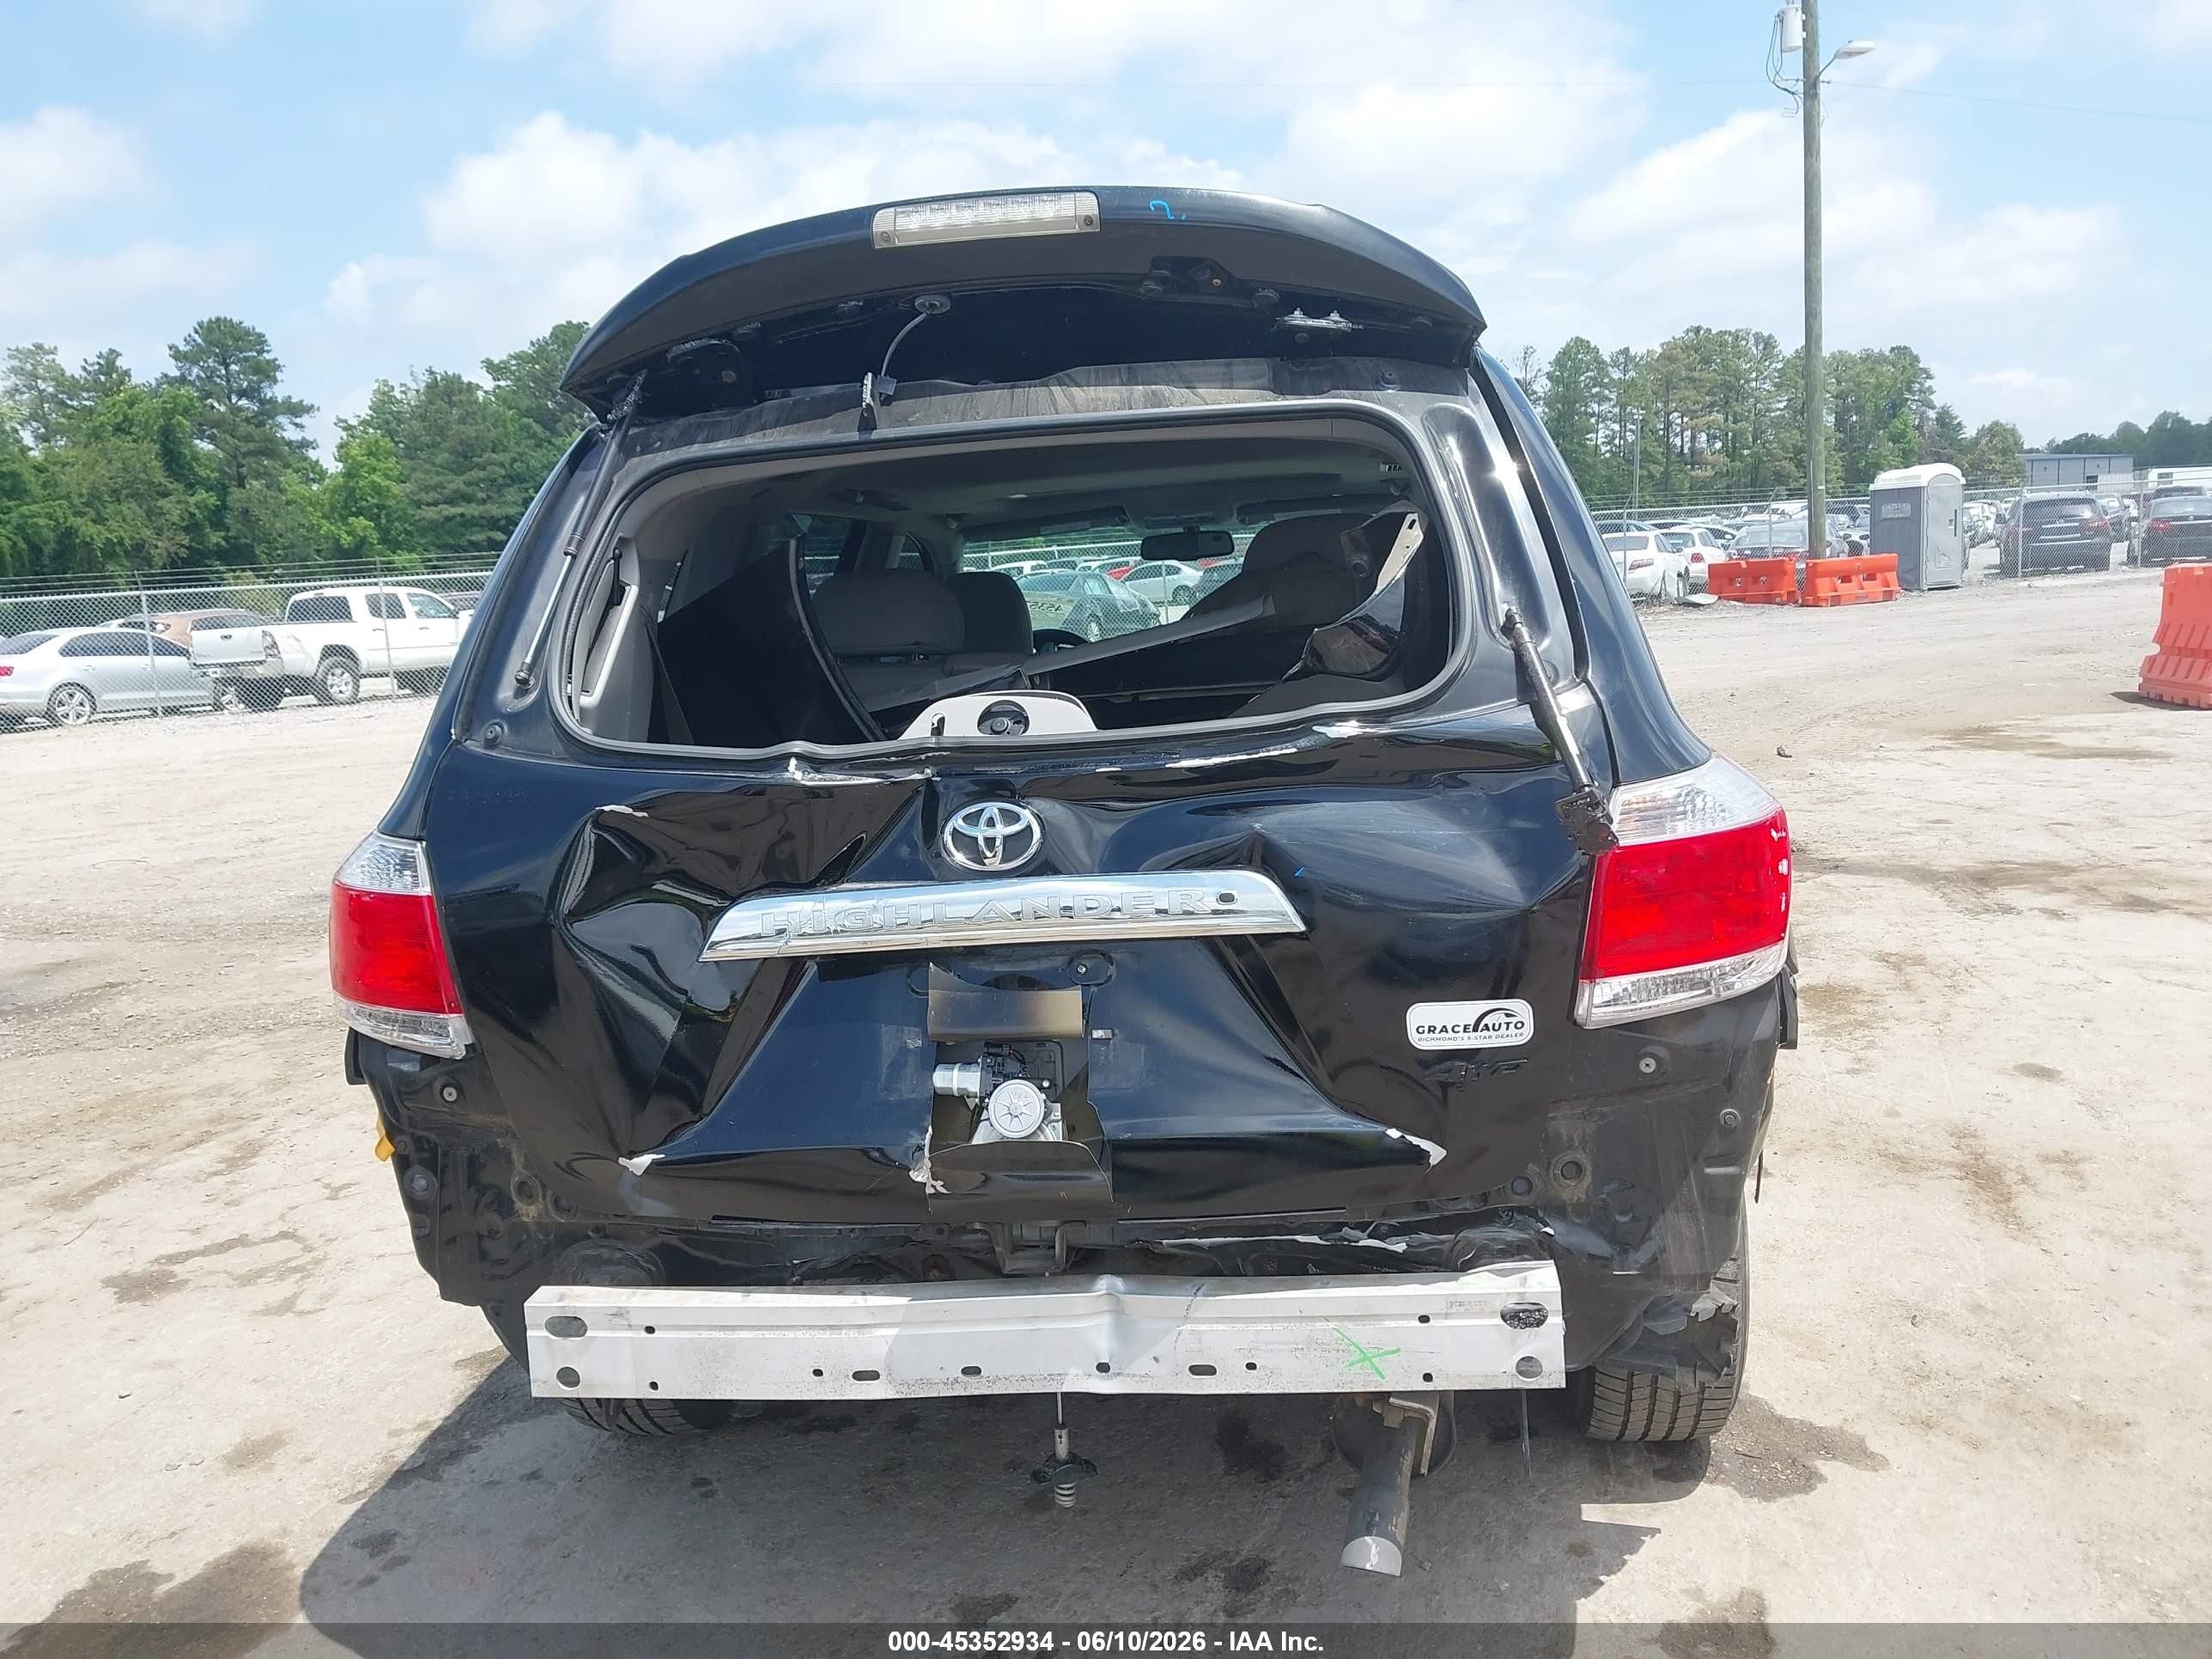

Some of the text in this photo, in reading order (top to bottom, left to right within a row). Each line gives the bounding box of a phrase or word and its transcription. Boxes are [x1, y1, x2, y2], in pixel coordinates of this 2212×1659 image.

[761, 889, 1212, 936] HIGHLANDER
[1415, 1020, 1526, 1035] GRACE AUTO
